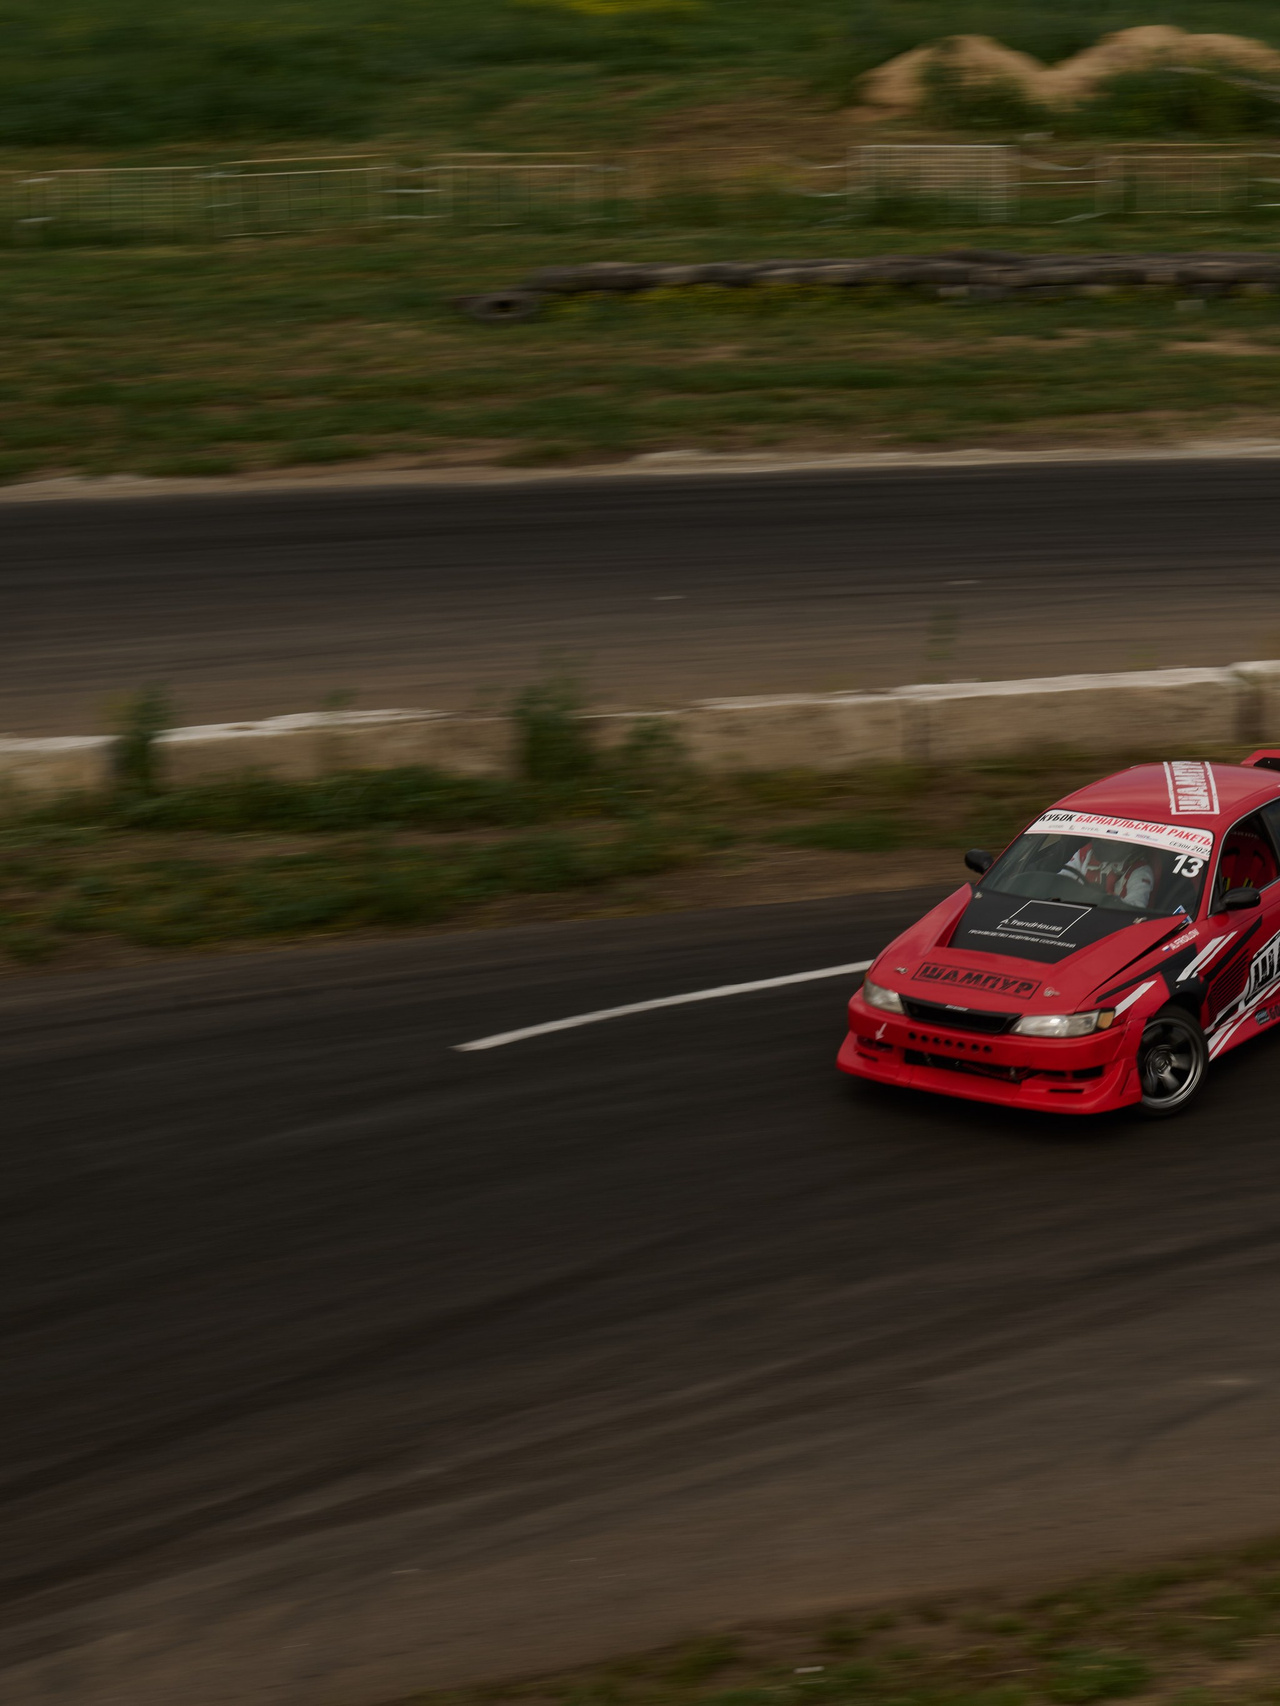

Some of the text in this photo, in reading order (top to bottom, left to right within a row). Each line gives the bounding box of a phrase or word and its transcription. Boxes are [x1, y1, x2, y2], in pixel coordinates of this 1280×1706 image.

[1039, 813, 1076, 823] КУБОК
[1075, 814, 1168, 835] БАРНАУЛЬСКОЙ
[1172, 854, 1204, 878] 13
[919, 965, 1034, 995] ШАМПУР
